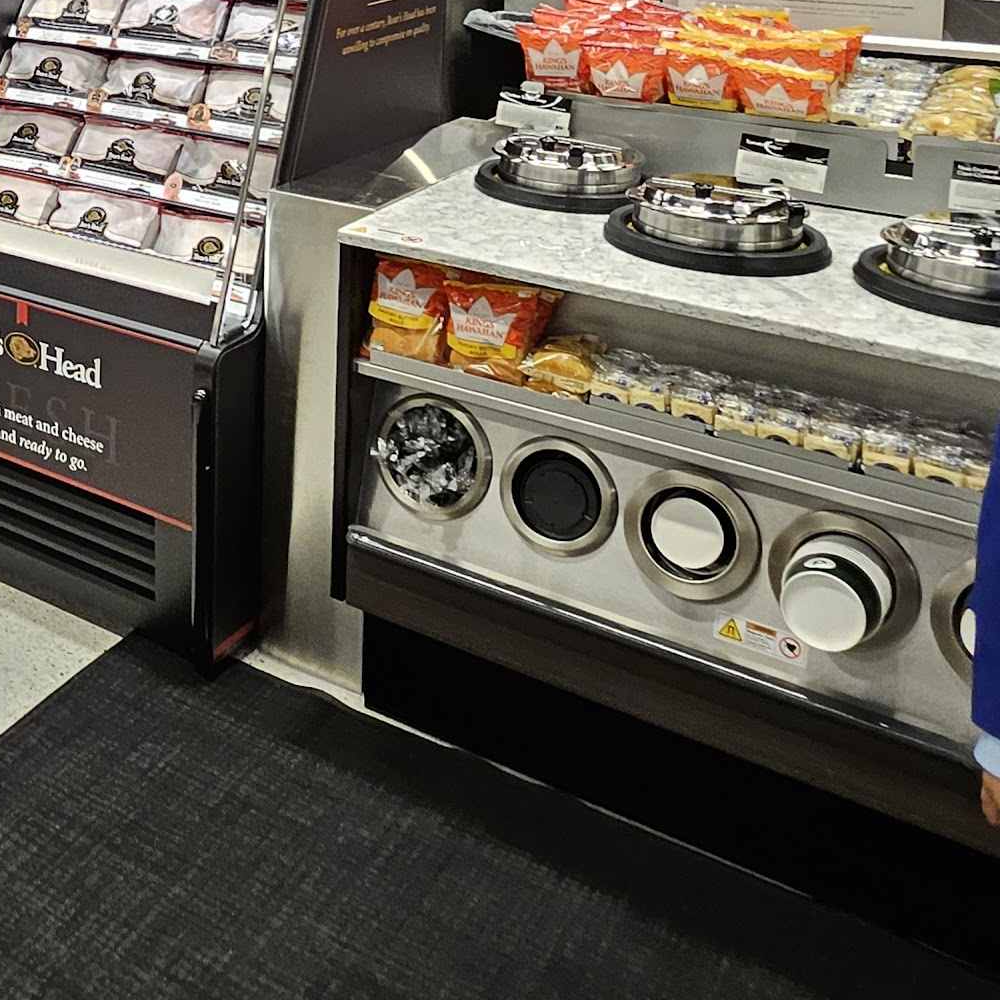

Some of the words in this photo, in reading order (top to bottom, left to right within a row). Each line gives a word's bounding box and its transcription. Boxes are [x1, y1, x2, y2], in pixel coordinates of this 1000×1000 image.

[676, 85, 720, 96] HAWAIIAN
[456, 324, 503, 339] HAWAIIAN
[39, 341, 102, 388] Head
[4, 408, 33, 428] meat
[36, 417, 58, 436] and
[62, 425, 103, 453] cheese
[19, 433, 52, 460] ready
[55, 447, 67, 463] to
[69, 454, 88, 471] go.
